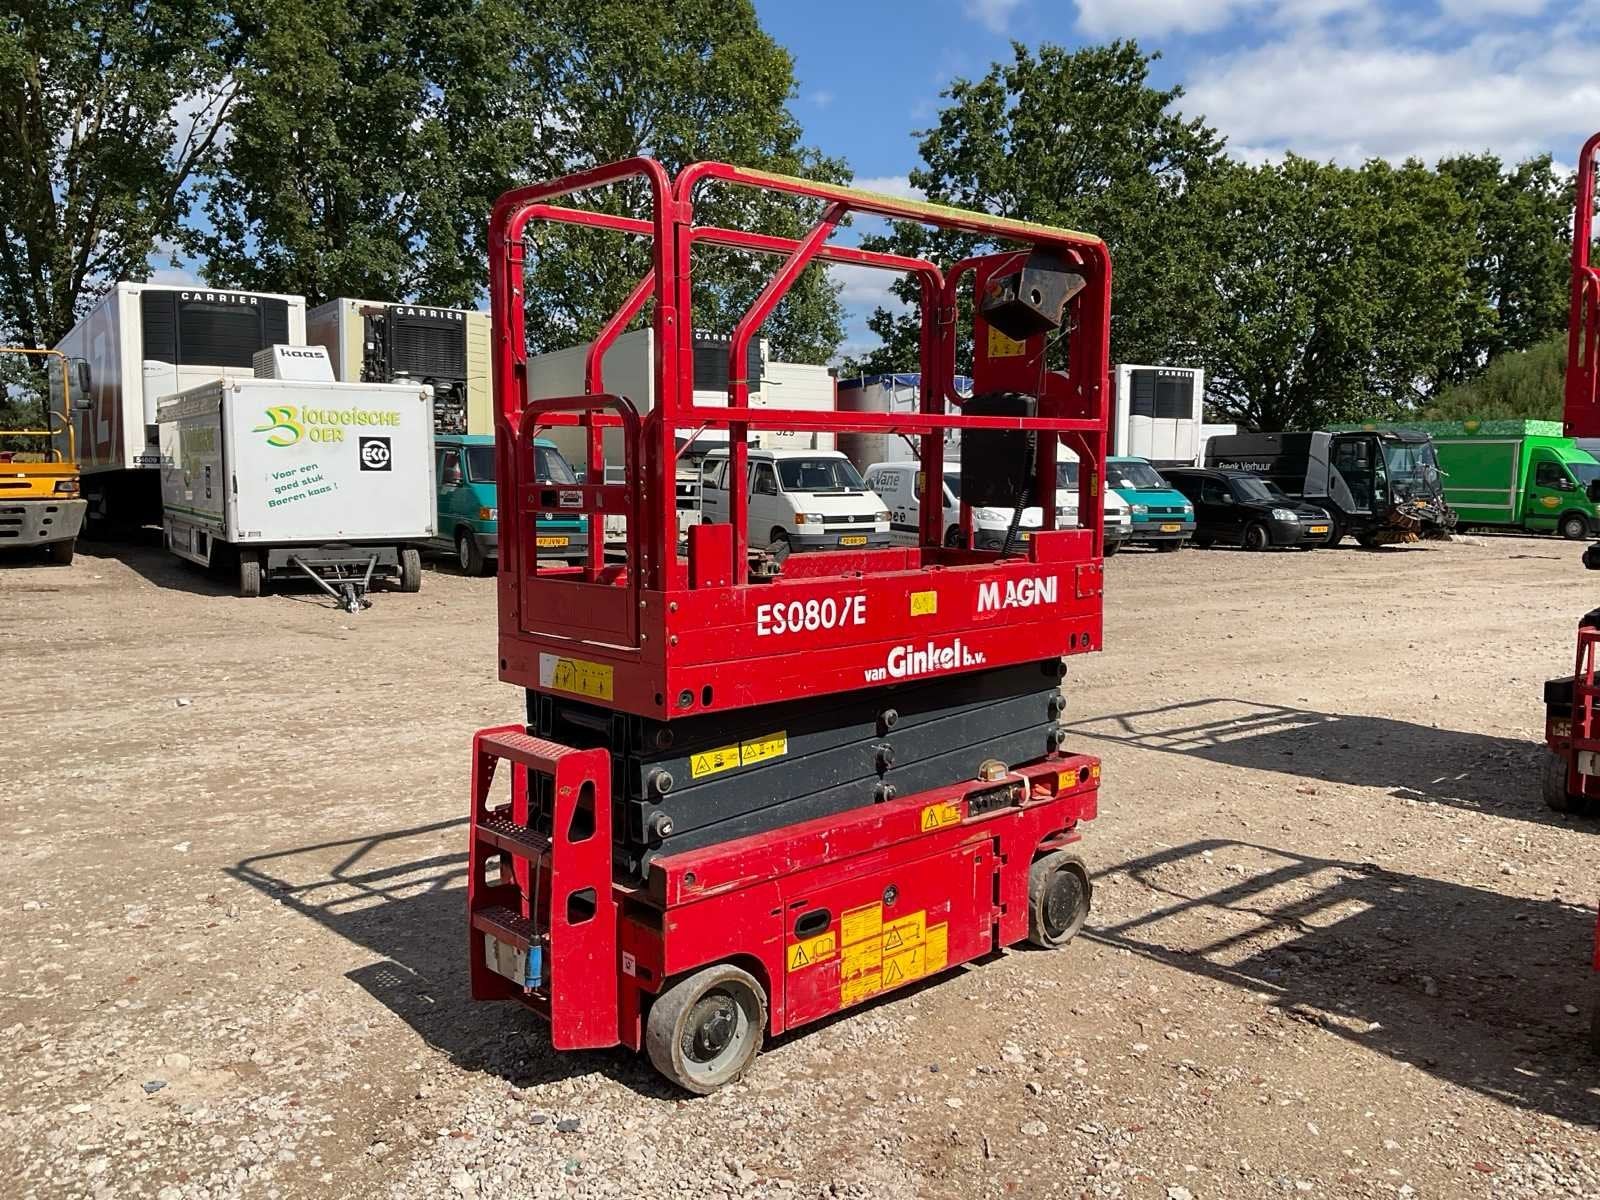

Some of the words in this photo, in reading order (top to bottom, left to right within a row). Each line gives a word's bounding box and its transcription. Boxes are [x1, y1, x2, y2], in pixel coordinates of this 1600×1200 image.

[181, 292, 258, 305] CARRIER
[396, 307, 462, 321] CARRIER
[695, 333, 733, 342] CARRI
[280, 348, 325, 359] kaas
[361, 446, 390, 462] EKO
[272, 469, 297, 480] Voor
[299, 463, 319, 473] een
[274, 480, 299, 495] goed
[301, 474, 324, 487] stuk
[307, 485, 333, 497] kaas
[977, 575, 1058, 613] MAGNI
[756, 594, 867, 637] ES080/E
[864, 666, 887, 683] van
[887, 637, 961, 678] Ginkel
[962, 645, 987, 666] b.v.
